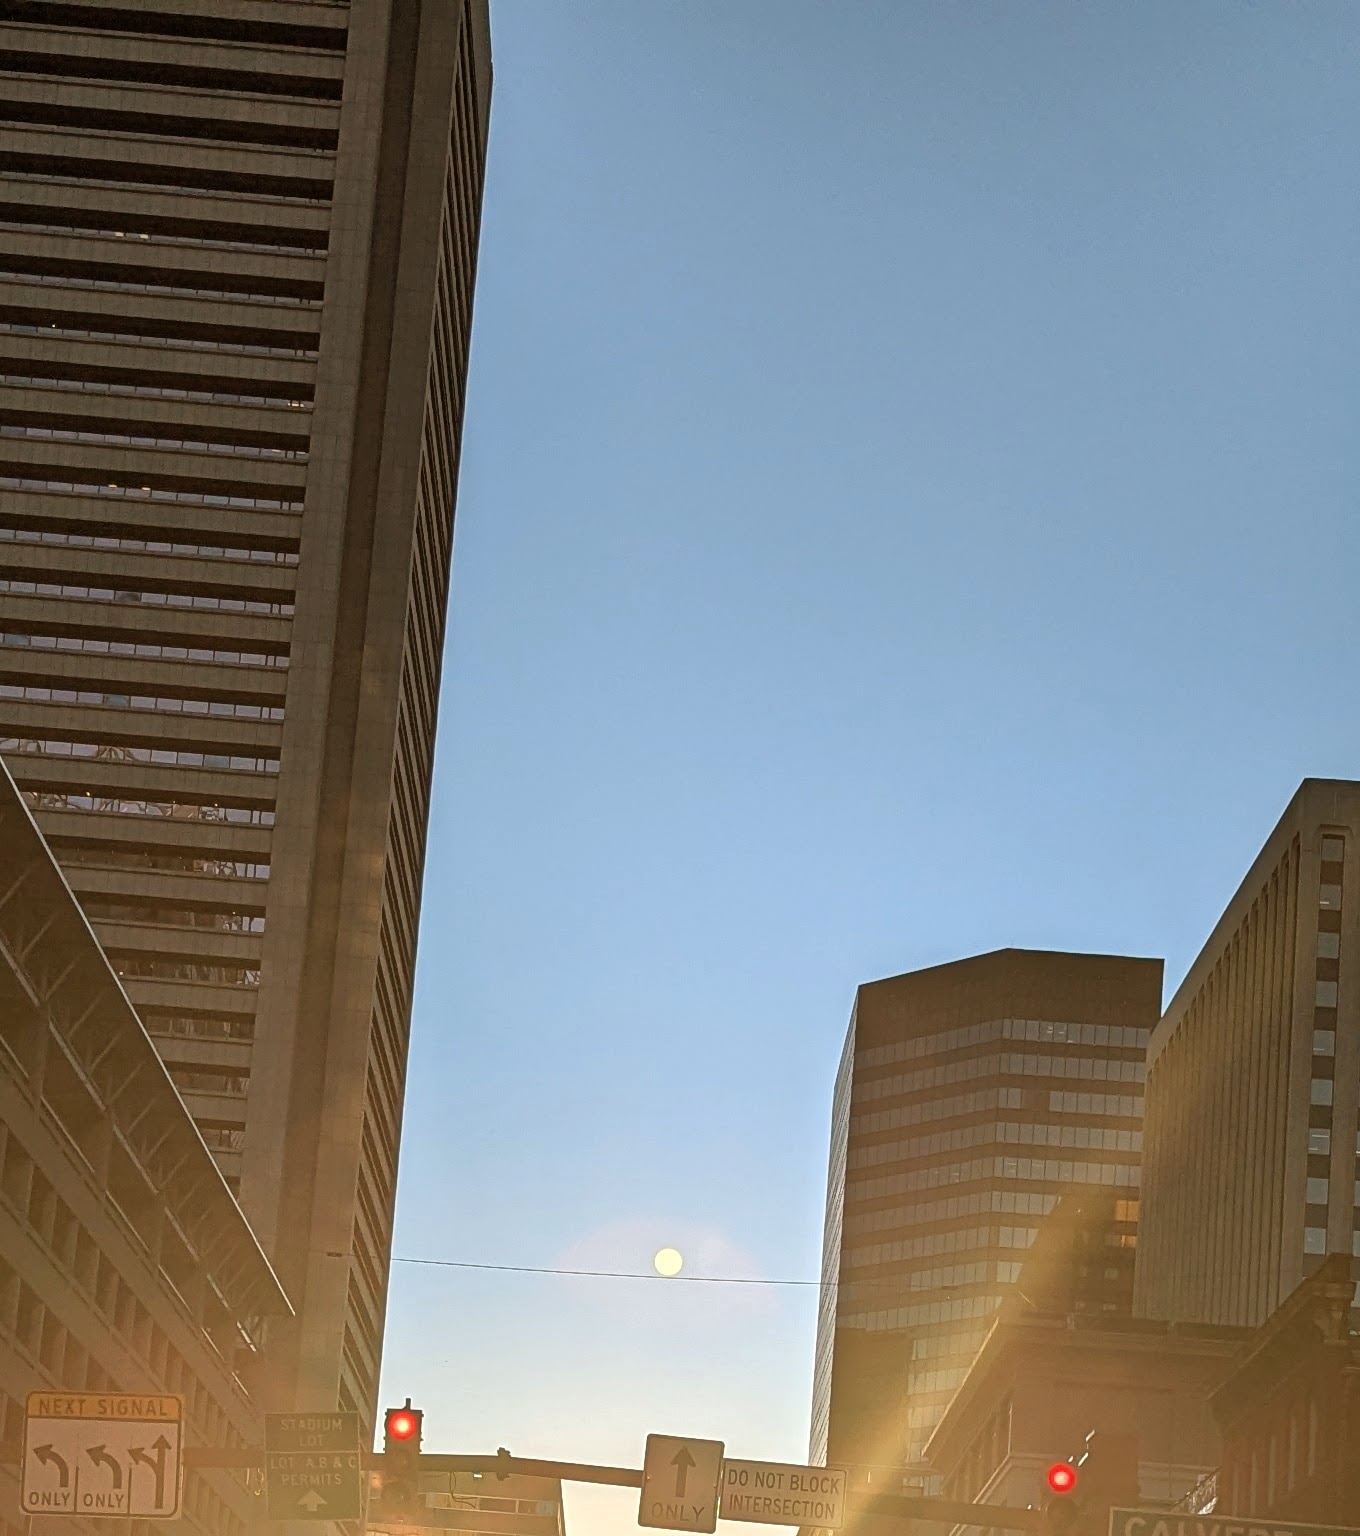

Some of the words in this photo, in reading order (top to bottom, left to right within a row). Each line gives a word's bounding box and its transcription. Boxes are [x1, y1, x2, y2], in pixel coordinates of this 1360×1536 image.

[38, 1399, 87, 1417] NEXT
[97, 1400, 168, 1418] SIGNAL
[280, 1417, 343, 1433] STADIUM
[299, 1434, 327, 1447] LOT
[270, 1456, 296, 1470] LOT
[333, 1456, 342, 1469] &
[347, 1456, 357, 1469] C
[280, 1473, 343, 1488] PERMITS
[727, 1468, 750, 1487] DO
[754, 1471, 785, 1490] NOT
[789, 1474, 841, 1495] BLOCK
[28, 1491, 71, 1507] ONLY
[83, 1492, 125, 1509] ONLY
[728, 1493, 836, 1520] INTERSECTION
[650, 1501, 705, 1524] ONLY
